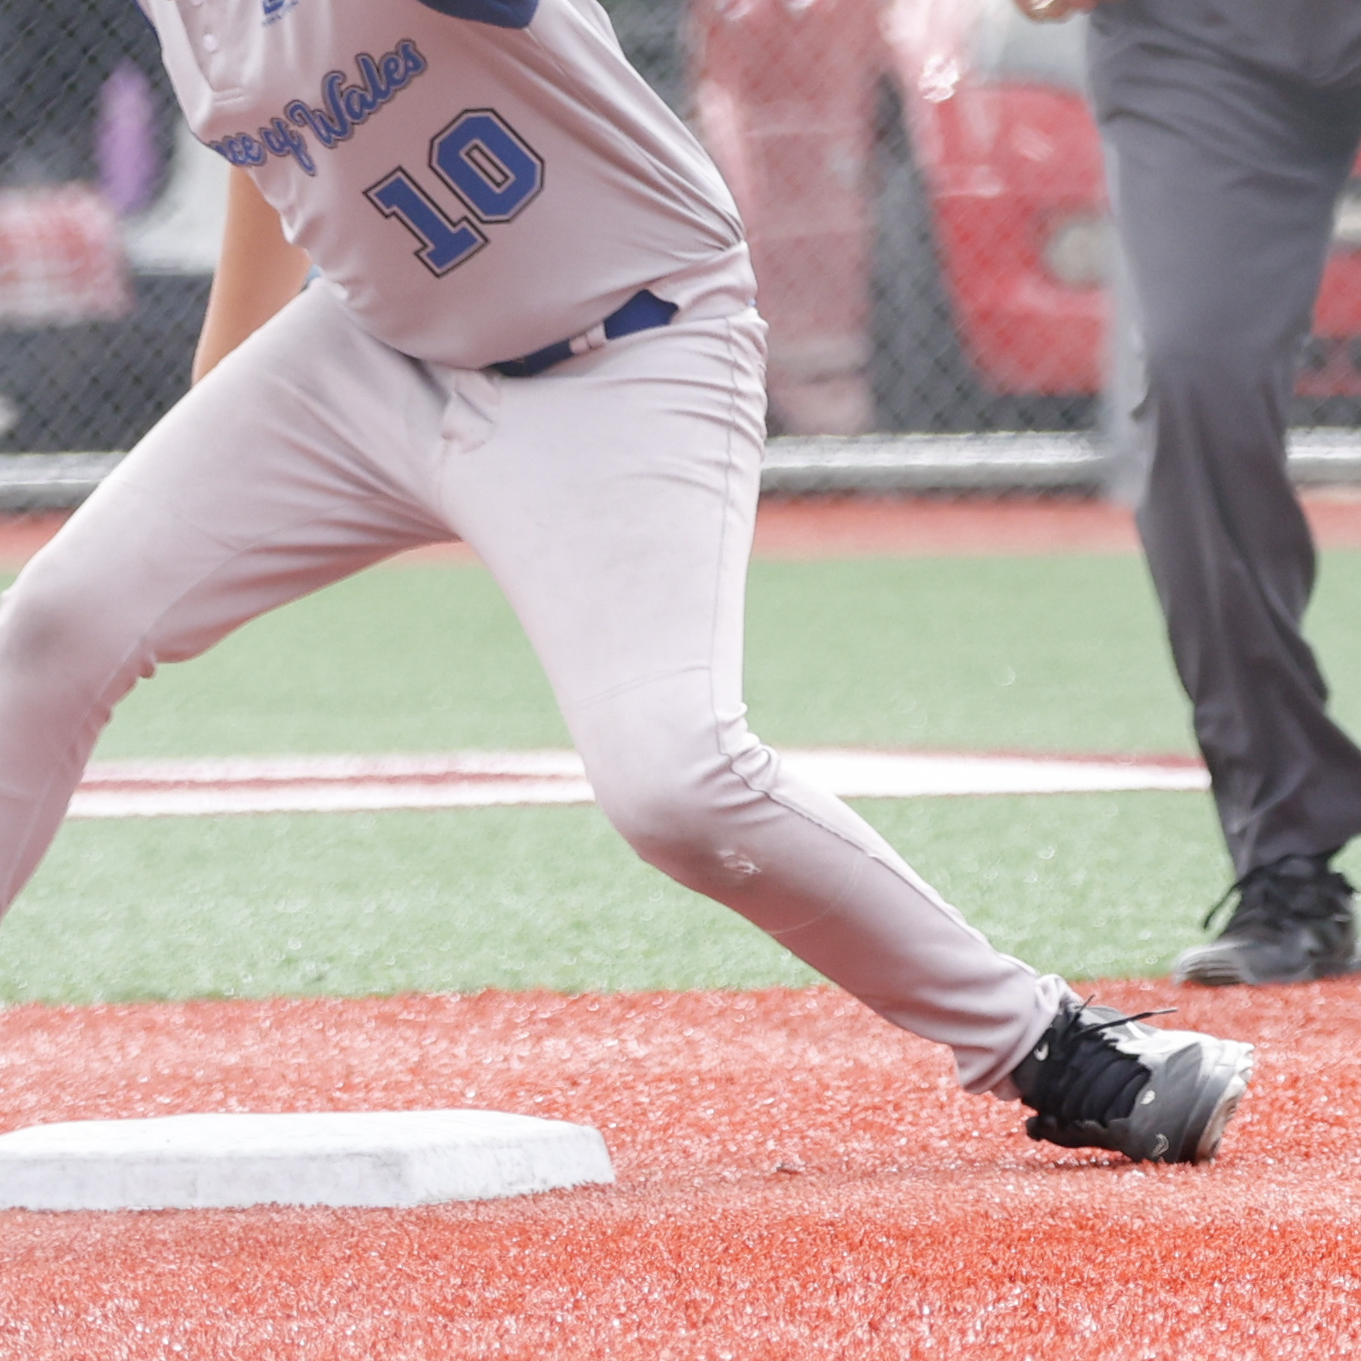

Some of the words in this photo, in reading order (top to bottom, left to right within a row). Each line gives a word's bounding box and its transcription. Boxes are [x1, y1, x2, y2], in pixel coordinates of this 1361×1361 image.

[258, 118, 316, 176] of
[284, 39, 427, 149] Wales
[363, 108, 546, 278] 10
